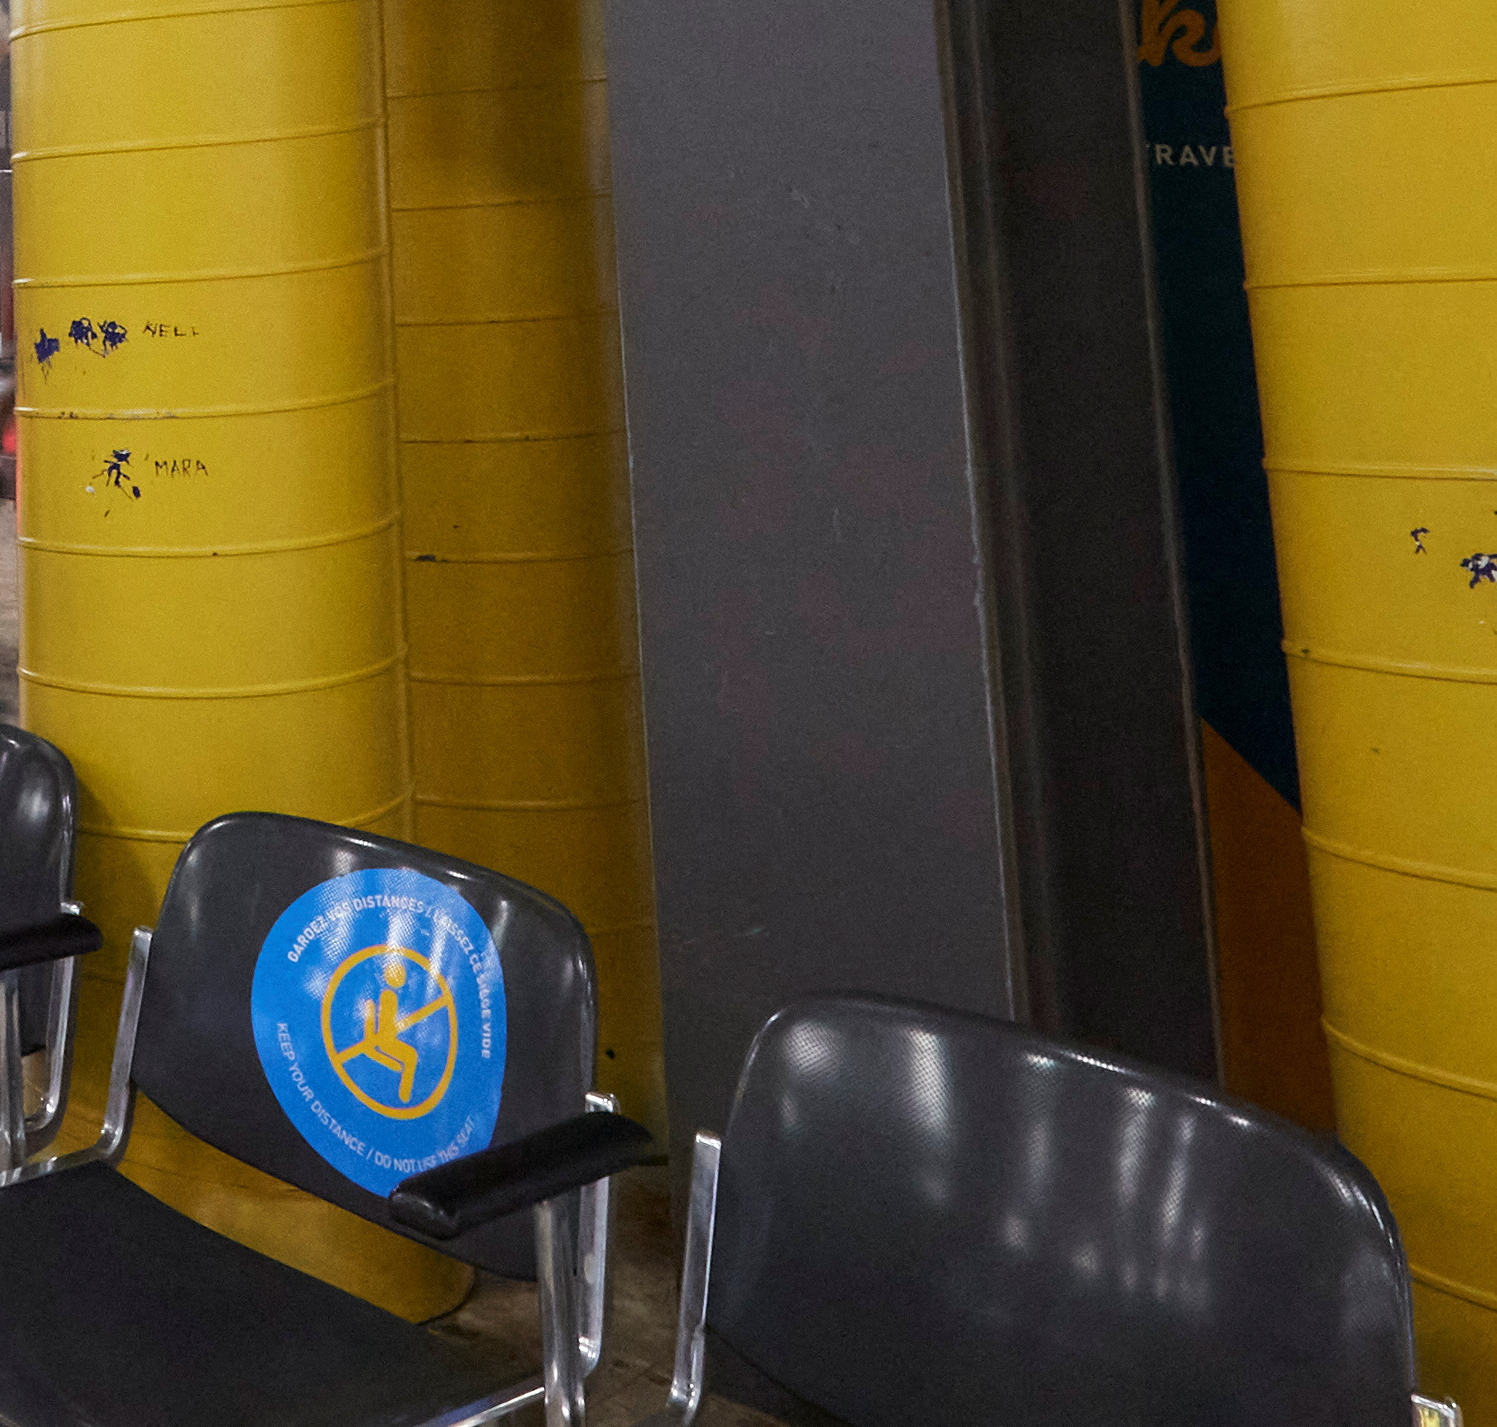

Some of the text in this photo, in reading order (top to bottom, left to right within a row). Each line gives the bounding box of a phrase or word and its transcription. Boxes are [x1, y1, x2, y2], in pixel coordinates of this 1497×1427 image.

[287, 914, 328, 963] GARDEZ
[352, 895, 425, 913] DISTANCES
[481, 1023, 492, 1059] VIDE
[277, 1022, 296, 1061] KEEP
[289, 1062, 314, 1102] YOUR
[311, 1100, 366, 1157] DISTANCE
[374, 1151, 392, 1169] DO
[393, 1158, 416, 1174] NOT
